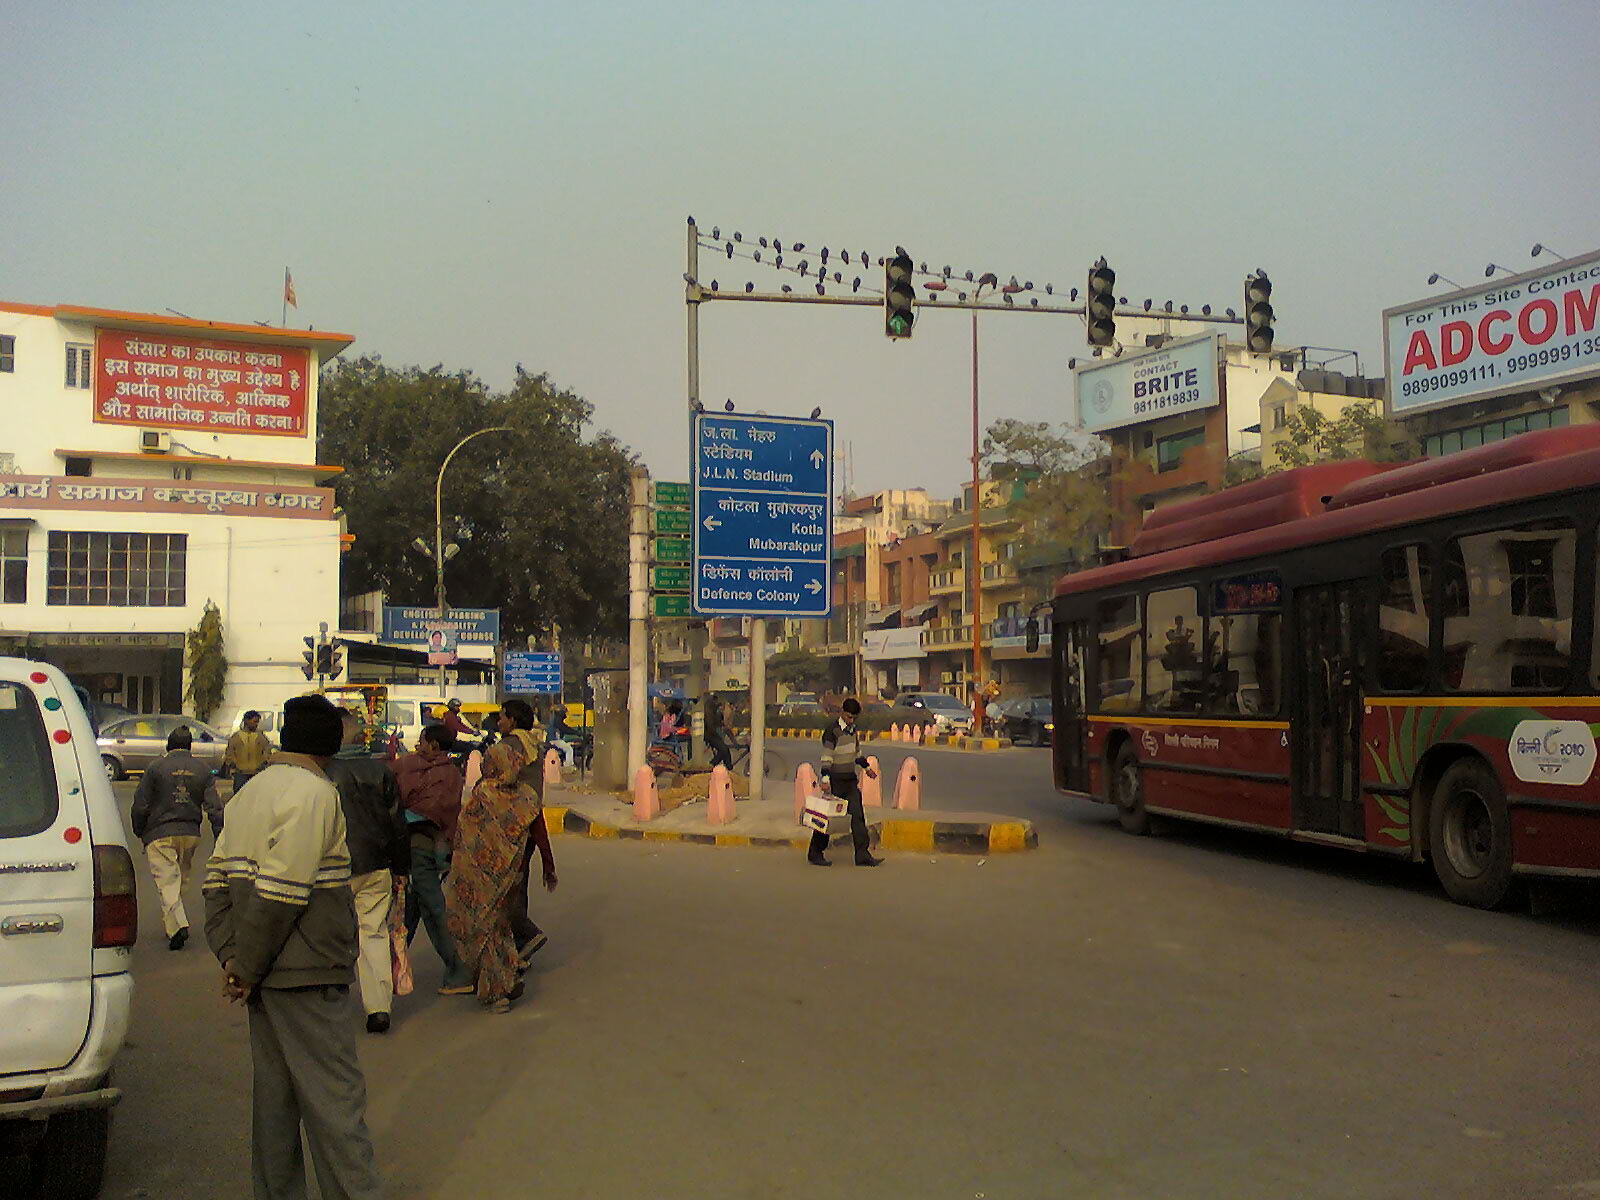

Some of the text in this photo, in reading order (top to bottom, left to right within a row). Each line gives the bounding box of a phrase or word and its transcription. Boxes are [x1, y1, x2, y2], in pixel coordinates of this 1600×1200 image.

[1405, 313, 1433, 326] For
[1440, 302, 1478, 318] This
[1485, 288, 1521, 306] Site
[1403, 283, 1600, 376] ADCOM
[126, 337, 283, 368] संसार का उपकार करना
[105, 358, 129, 376] इस
[134, 361, 178, 378] समाज
[183, 366, 202, 380] का
[206, 368, 241, 387] मुख्य
[288, 369, 301, 391] है
[1133, 360, 1179, 379] CONTACT
[1134, 368, 1198, 398] BRITE
[236, 388, 290, 408] आत्मिक
[1134, 389, 1200, 414] 9811819839
[102, 397, 131, 418] और
[135, 402, 205, 423] सामाजिक
[208, 407, 251, 427] उन्नति
[703, 442, 753, 461] स्टेडियम
[703, 466, 793, 483] J.L.N. Stadium
[58, 484, 147, 502] समाज
[264, 493, 326, 511] नगर
[718, 496, 760, 513] कोटला
[791, 522, 824, 535] Kotla
[749, 537, 823, 555] Mubarakpur
[701, 587, 801, 605] Defence Colony
